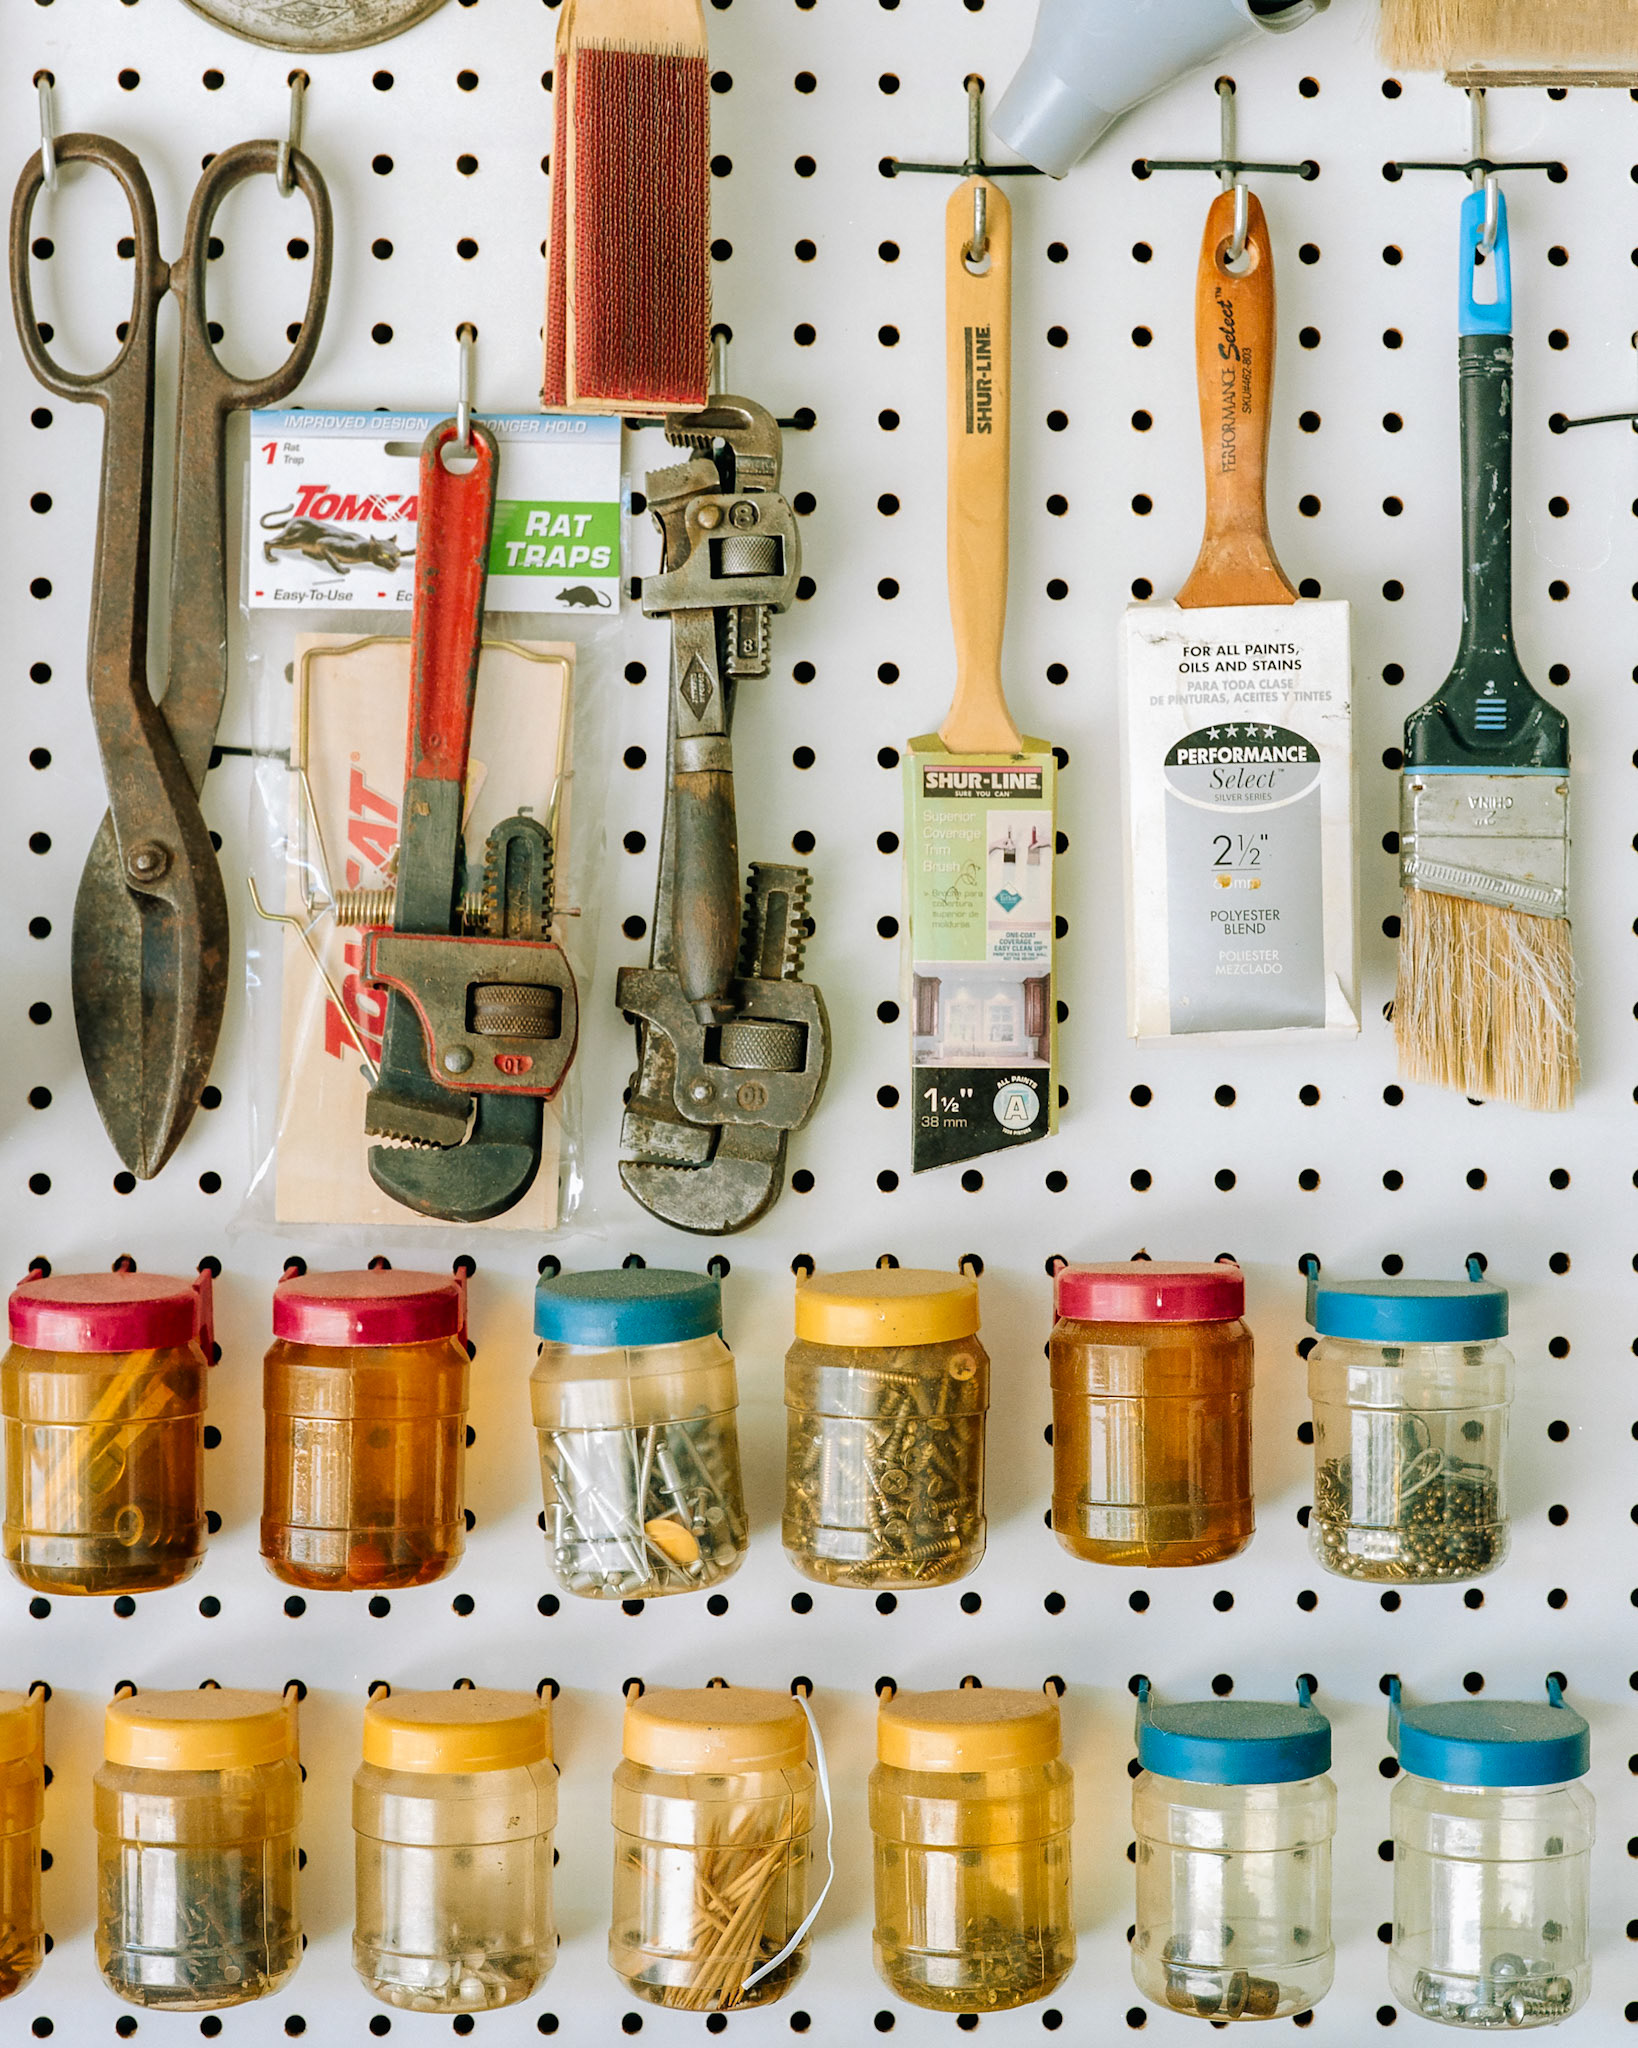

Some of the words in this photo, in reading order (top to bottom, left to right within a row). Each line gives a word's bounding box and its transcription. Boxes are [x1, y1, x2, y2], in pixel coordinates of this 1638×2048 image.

[976, 326, 992, 434] SHUR-LINE
[1242, 347, 1252, 414] SKU#462-803
[284, 415, 366, 430] IMPROVED
[371, 417, 429, 431] DESIGN
[482, 419, 539, 433] ONGER
[545, 421, 587, 433] HOLD
[1221, 368, 1236, 474] PERFORMANCE
[262, 442, 278, 465] 1
[284, 443, 300, 452] Rat
[284, 455, 304, 465] Trap
[293, 484, 419, 522] TOMCA
[525, 510, 592, 538] RAT
[506, 541, 611, 570] TRAPS
[274, 589, 353, 603] Easy-To-Use
[1183, 646, 1211, 657] FOR
[1216, 645, 1240, 656] ALL
[1245, 643, 1300, 656] PAINTS,
[1179, 662, 1210, 674] OILS
[1214, 661, 1247, 672] AND
[1252, 660, 1302, 671] STAINS
[1187, 681, 1219, 692] PARA
[1222, 679, 1255, 691] TODA
[1259, 678, 1294, 690] CLASE
[1150, 696, 1165, 706] DE
[1168, 693, 1230, 705] PINTURAS,
[1233, 692, 1279, 703] ACEITES
[1281, 692, 1290, 702] Y
[1294, 691, 1332, 702] TINTES
[1177, 746, 1308, 765] PERFORMANCE
[925, 772, 1039, 789] SHUR-LINE
[976, 790, 991, 798] YOU
[1214, 793, 1242, 802] SILVER
[1244, 792, 1272, 801] SERIES
[1468, 796, 1513, 809] CHINA
[923, 810, 976, 824] Superior
[923, 826, 981, 841] Coverage
[923, 843, 951, 856] Trim
[923, 860, 960, 872] Brush
[1210, 909, 1280, 922] POLYESTER
[1224, 923, 1266, 935] BLEND
[1219, 950, 1279, 961] POLIESTER
[1215, 963, 1283, 975] MEZCLADO
[997, 1077, 1011, 1089] ALL
[1011, 1075, 1038, 1090] PAINTS
[1004, 1094, 1029, 1120] A
[921, 1116, 939, 1128] 38
[944, 1117, 968, 1128] mm
